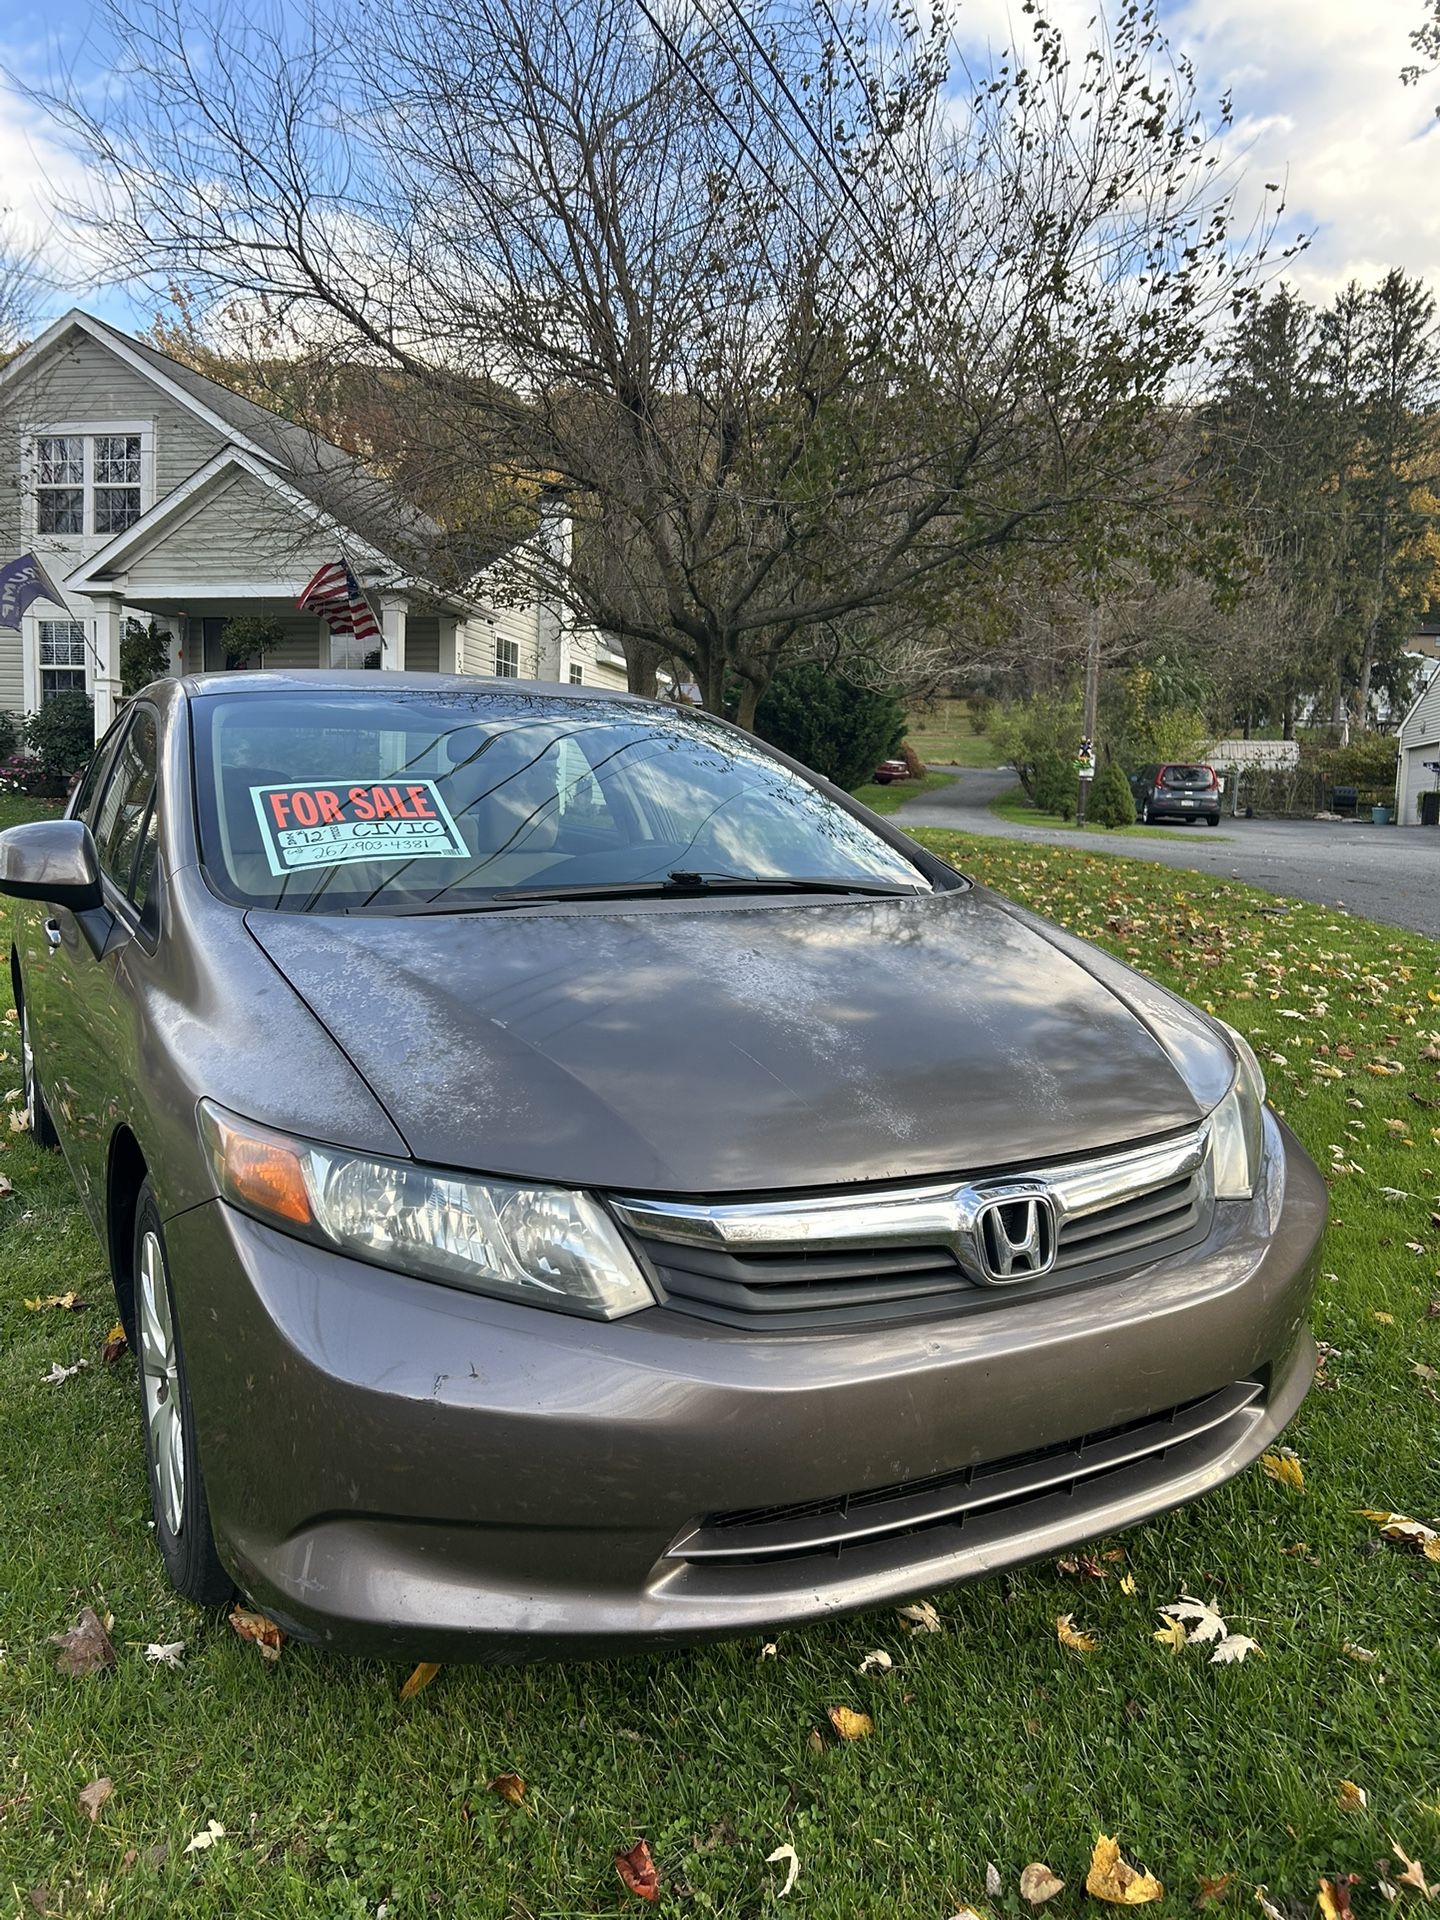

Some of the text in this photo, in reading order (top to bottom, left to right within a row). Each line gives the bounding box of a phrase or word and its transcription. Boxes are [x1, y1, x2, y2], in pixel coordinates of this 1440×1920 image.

[269, 786, 437, 829] FOR SALE
[352, 822, 440, 837] CIVIC
